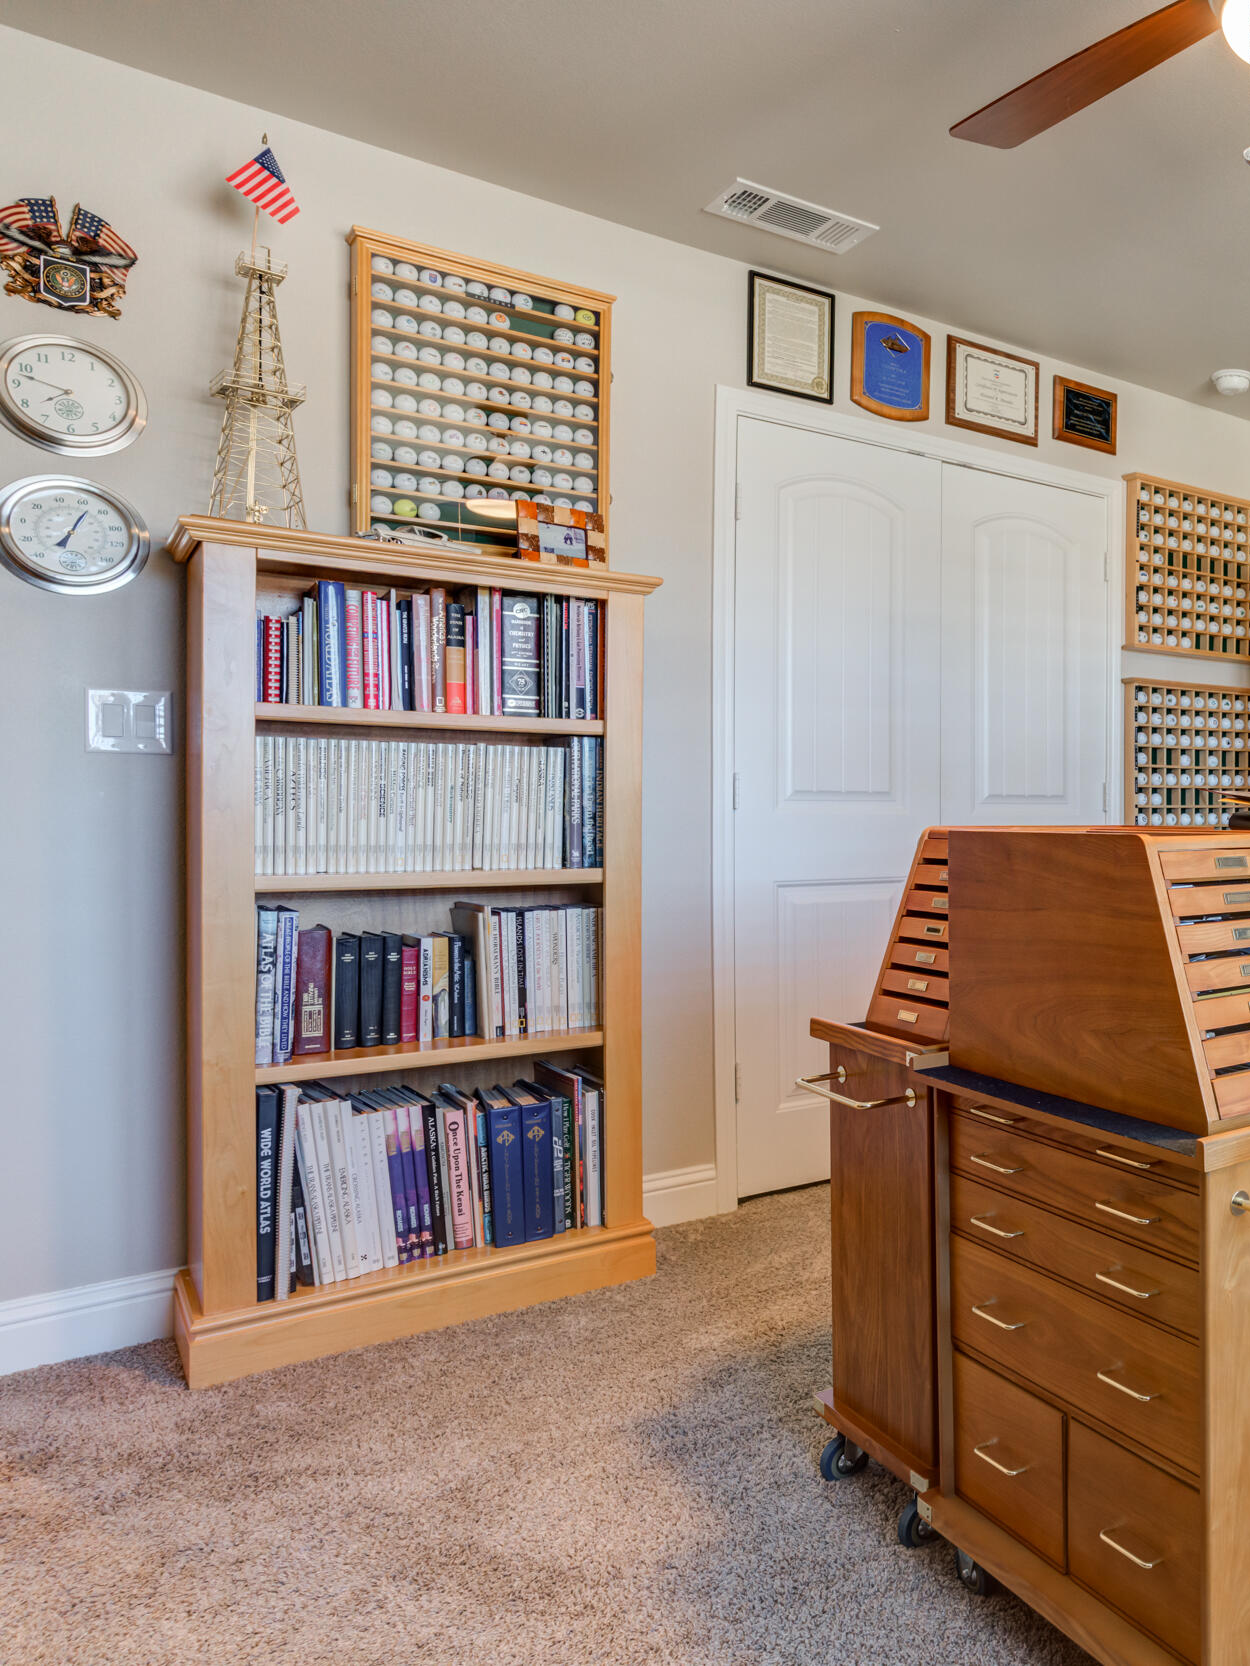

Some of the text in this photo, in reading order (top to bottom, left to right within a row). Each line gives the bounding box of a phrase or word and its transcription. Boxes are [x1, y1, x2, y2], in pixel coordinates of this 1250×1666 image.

[36, 352, 49, 364] 11
[60, 351, 76, 362] 12
[90, 362, 95, 371] 1
[18, 363, 33, 374] 10
[12, 378, 21, 388] 9
[107, 378, 115, 388] 2
[20, 399, 30, 408] 8
[114, 396, 122, 406] 3
[40, 414, 50, 424] 7
[92, 422, 100, 432] 5
[109, 412, 117, 421] 4
[66, 424, 76, 434] 6
[326, 624, 336, 662] WORLD
[346, 604, 360, 690] COMPETING FUTURE
[432, 616, 440, 662] Wonderlands
[326, 664, 337, 702] ATLAS
[572, 760, 580, 798] NATIONAL
[596, 770, 604, 802] INDIAN
[572, 799, 580, 824] PARKS
[596, 805, 604, 848] HERITAGE
[586, 833, 594, 854] Road
[516, 916, 524, 944] ISLANDS
[284, 936, 292, 954] PEOPLE
[492, 933, 500, 974] HORSEMAN'S
[518, 962, 524, 970] IN
[258, 933, 274, 1048] ATLAS OF THE BIBLE
[428, 1117, 436, 1149] ALASKA:
[448, 1121, 460, 1146] Once
[306, 1165, 314, 1174] THE
[322, 1162, 330, 1172] THE
[452, 1148, 460, 1171] Upon
[480, 1147, 488, 1172] ARCTIC
[260, 1128, 272, 1234] WIDE WORLD ATLAS
[454, 1172, 463, 1188] The
[343, 1200, 352, 1224] ALASKA
[457, 1190, 465, 1216] Kenai
[354, 1204, 362, 1224] ALASKA
